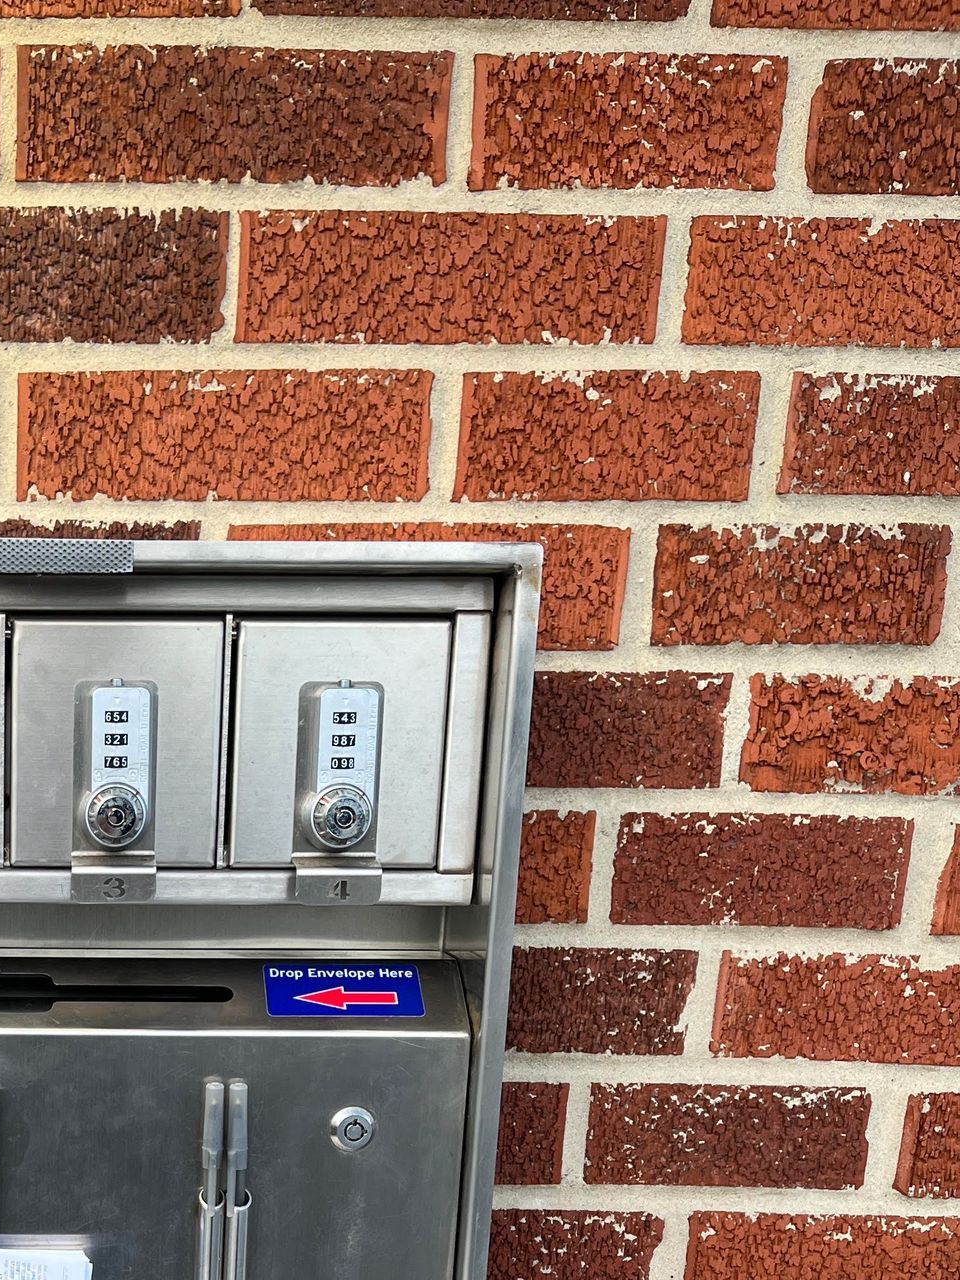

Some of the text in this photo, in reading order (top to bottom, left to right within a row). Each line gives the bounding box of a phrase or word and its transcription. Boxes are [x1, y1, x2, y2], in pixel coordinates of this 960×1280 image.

[105, 712, 127, 722] 654
[333, 713, 356, 723] 543
[105, 735, 127, 745] 321
[333, 736, 355, 746] 987
[105, 757, 127, 767] 765
[331, 758, 354, 769] 098
[102, 877, 126, 898] 3
[331, 880, 351, 900] 4
[269, 968, 413, 980] Drop Envelope Here
